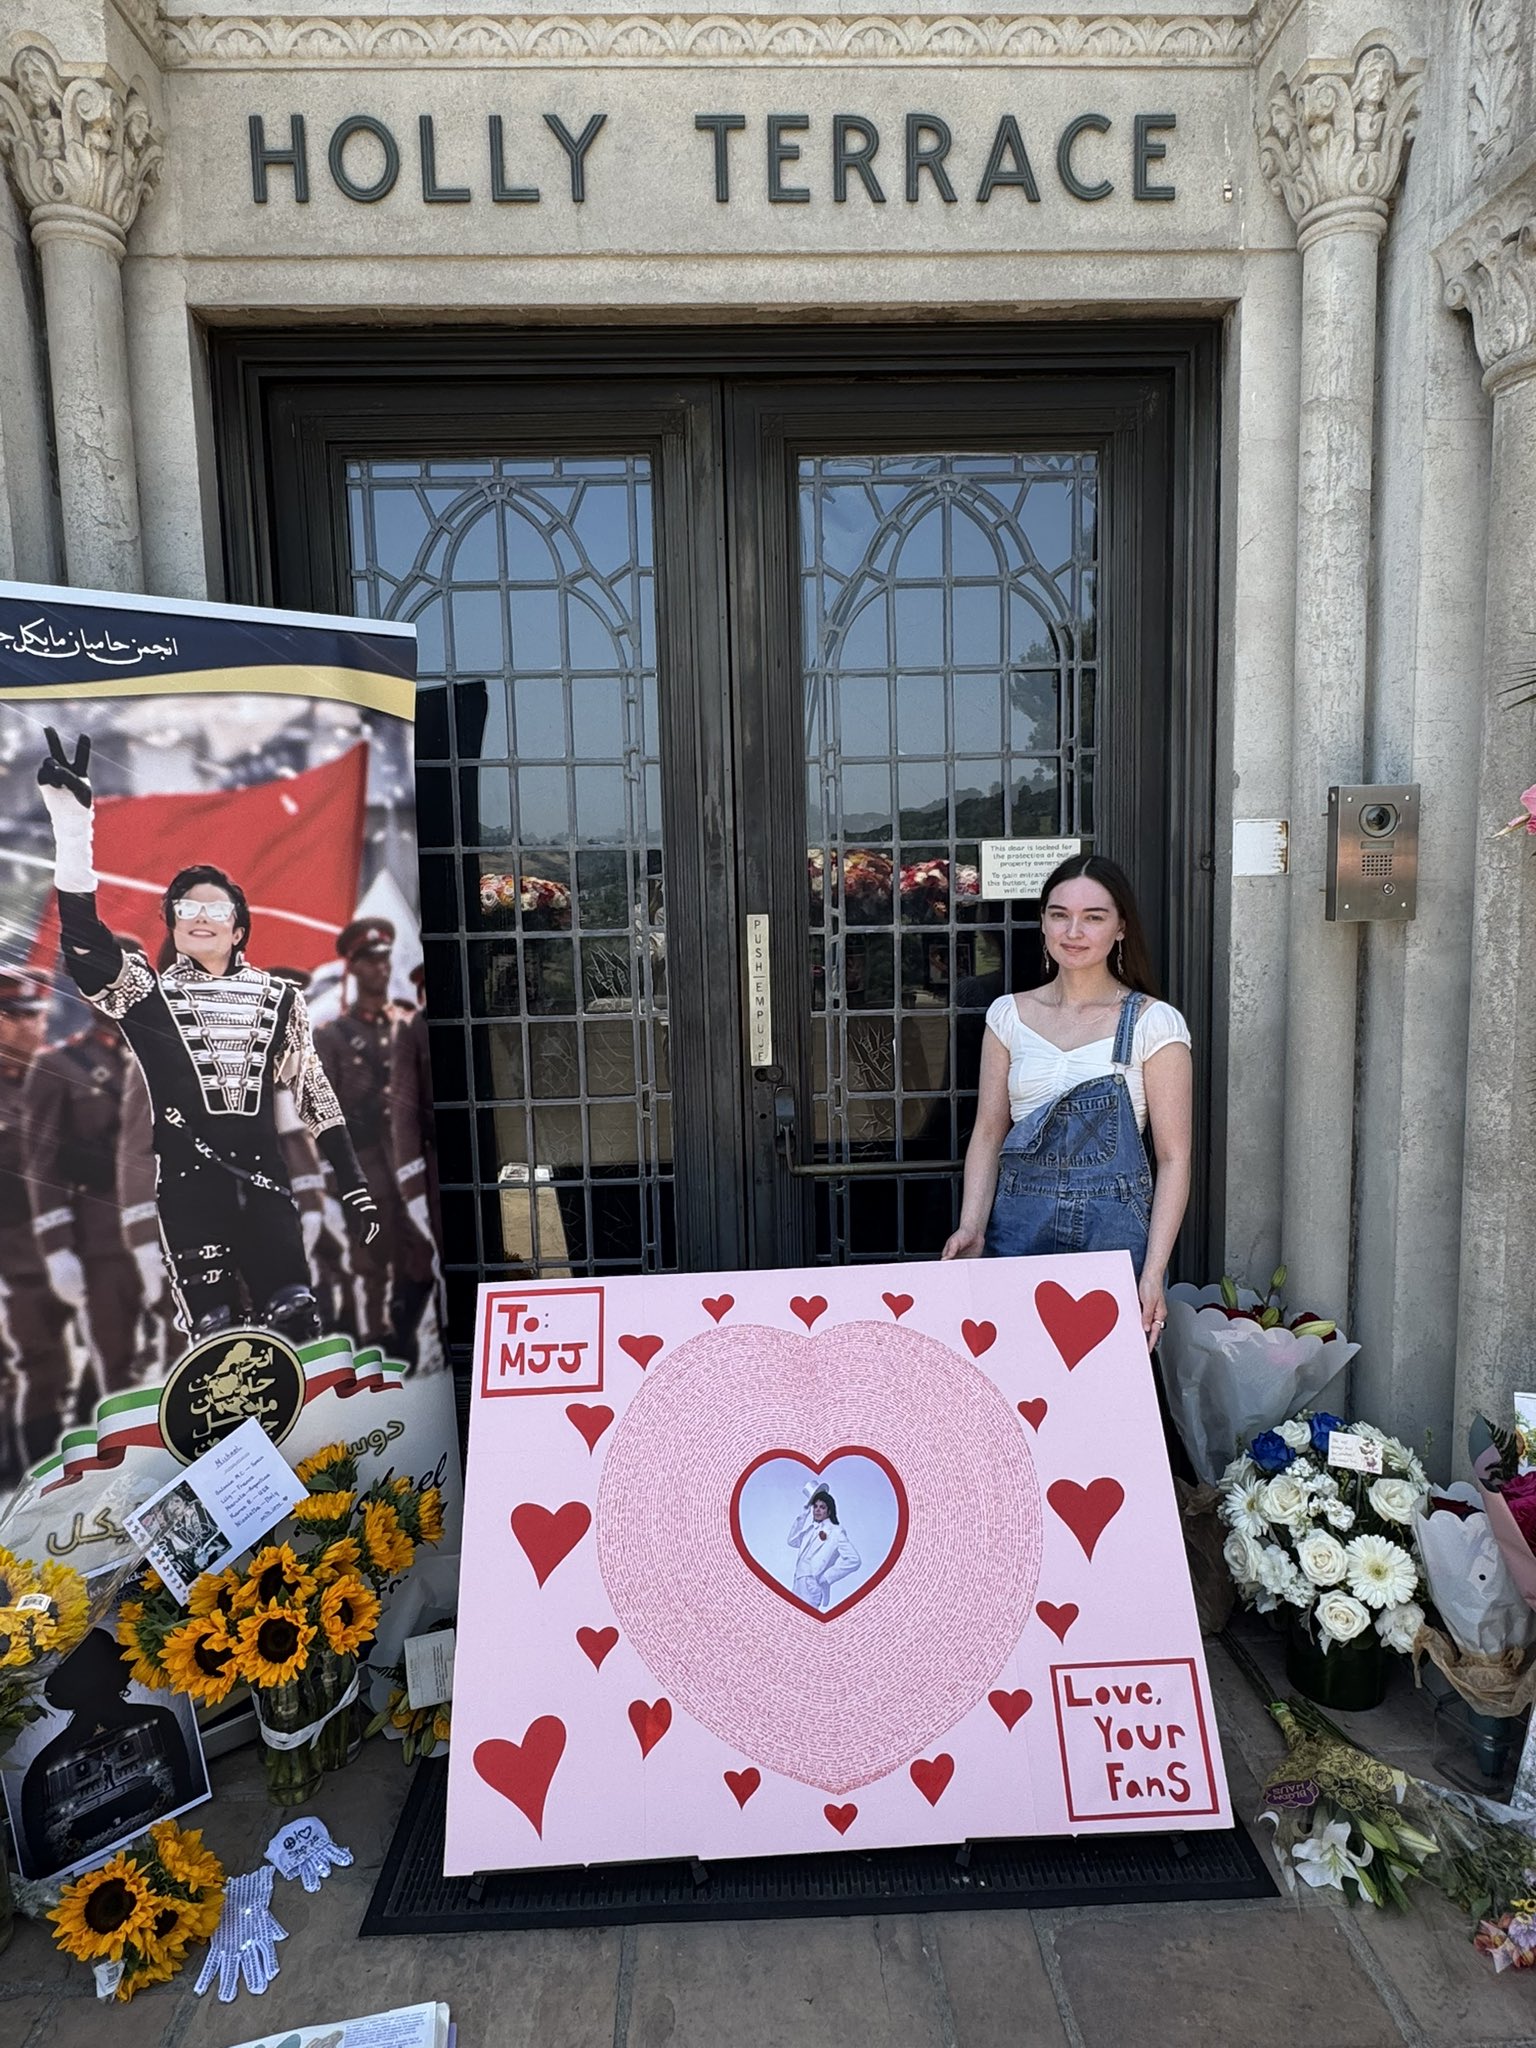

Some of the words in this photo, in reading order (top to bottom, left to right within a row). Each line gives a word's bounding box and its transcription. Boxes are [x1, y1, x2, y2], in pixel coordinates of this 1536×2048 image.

[249, 114, 607, 203] HOLLY
[695, 113, 1176, 203] TERRACE
[1002, 872, 1017, 880] gain
[753, 920, 763, 972] PUSH
[755, 982, 765, 1062] EMPUJE
[497, 1304, 549, 1335] To:
[500, 1342, 588, 1376] MJJ
[1064, 1675, 1162, 1707] Love,
[1272, 1782, 1305, 1795] HAUS
